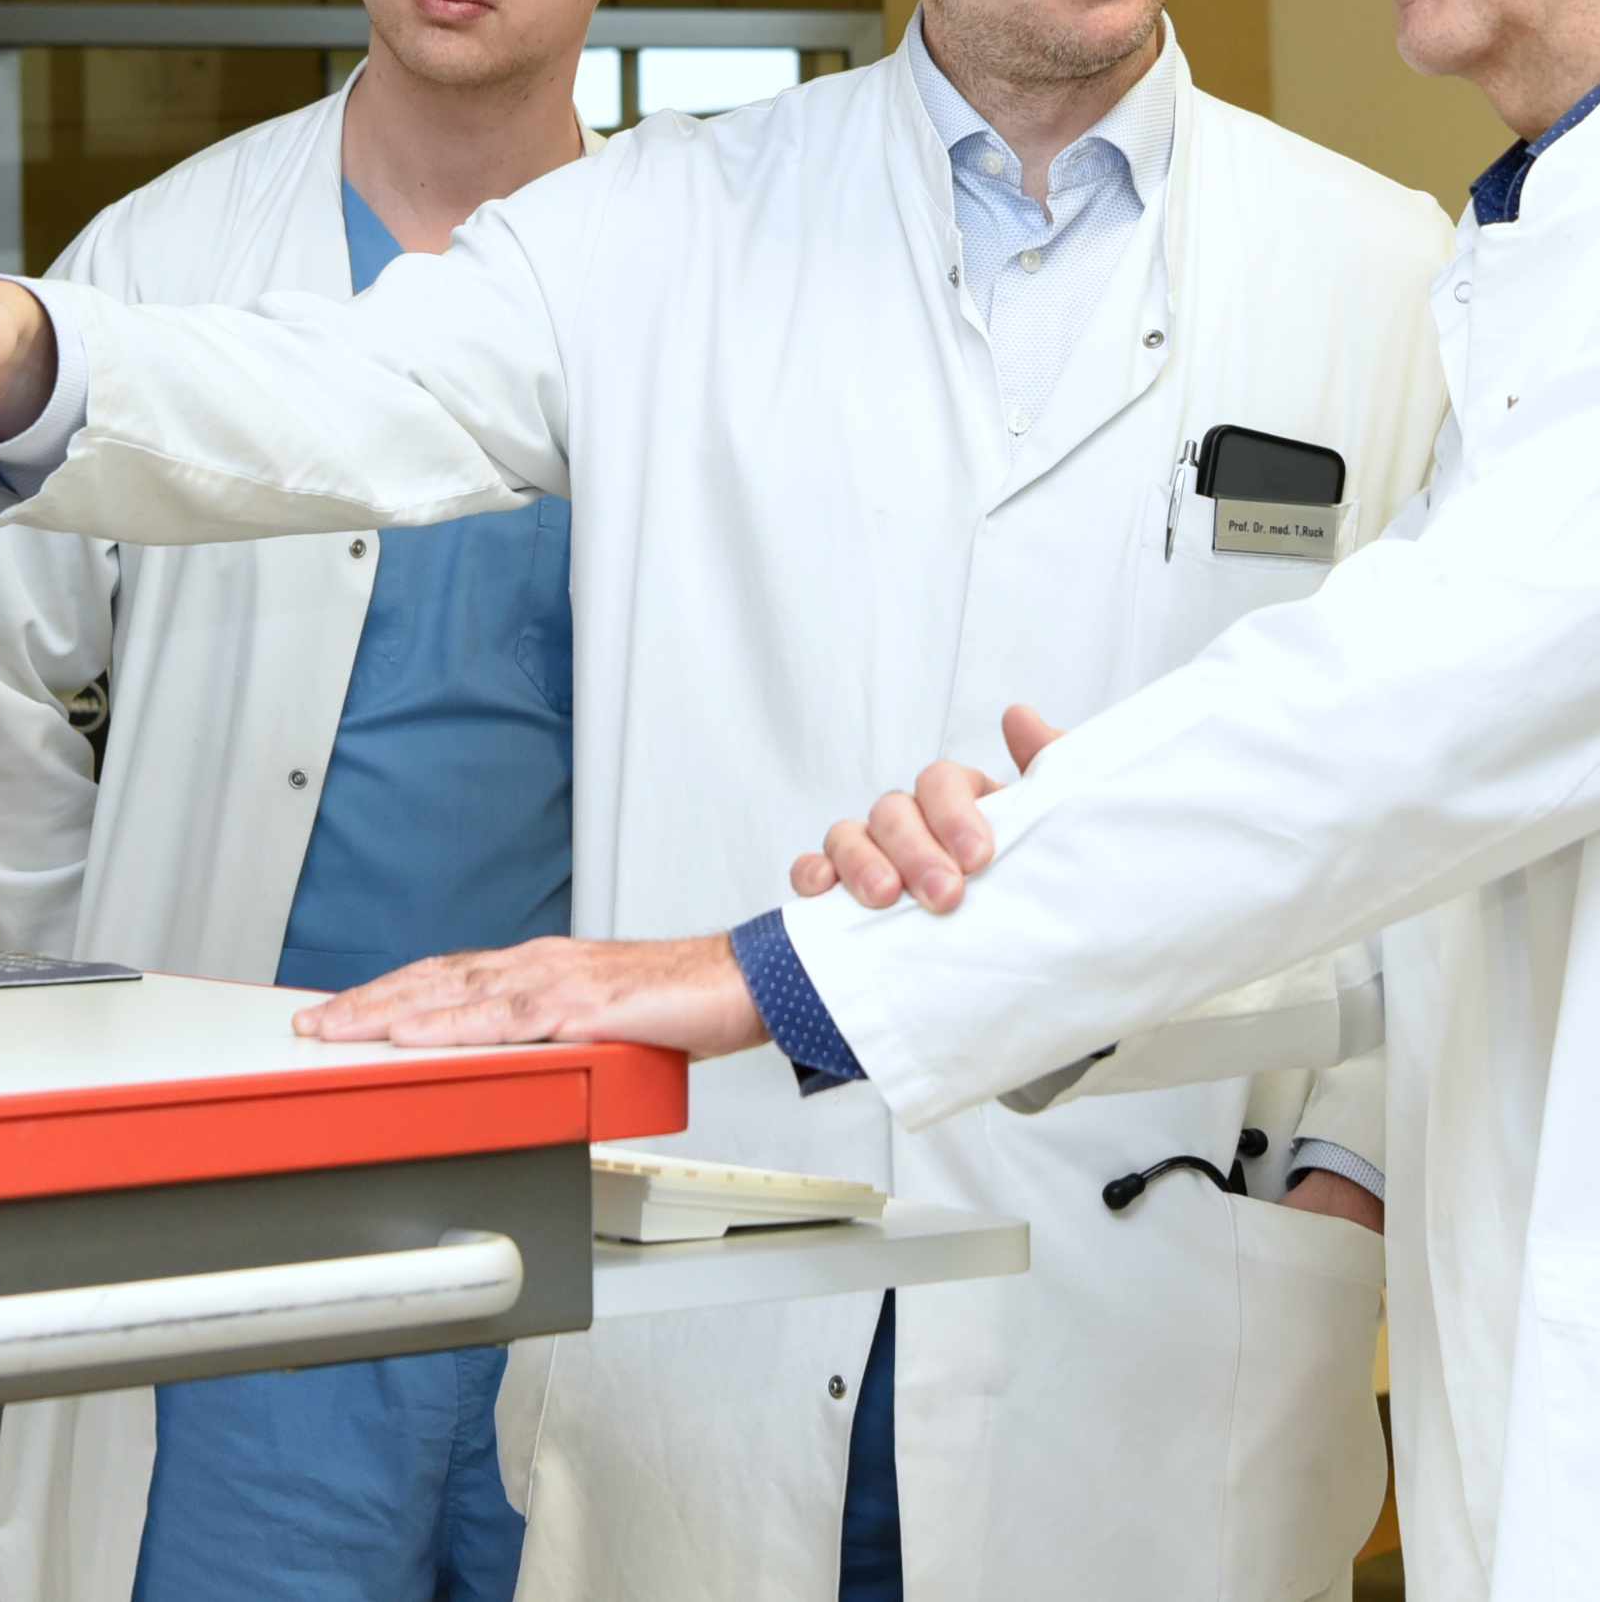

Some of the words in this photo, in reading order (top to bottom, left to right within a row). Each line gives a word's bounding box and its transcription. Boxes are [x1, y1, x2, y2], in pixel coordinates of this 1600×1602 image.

[1228, 519, 1250, 533] Prof.
[1252, 521, 1266, 535] Dr.
[1269, 524, 1292, 536] med.
